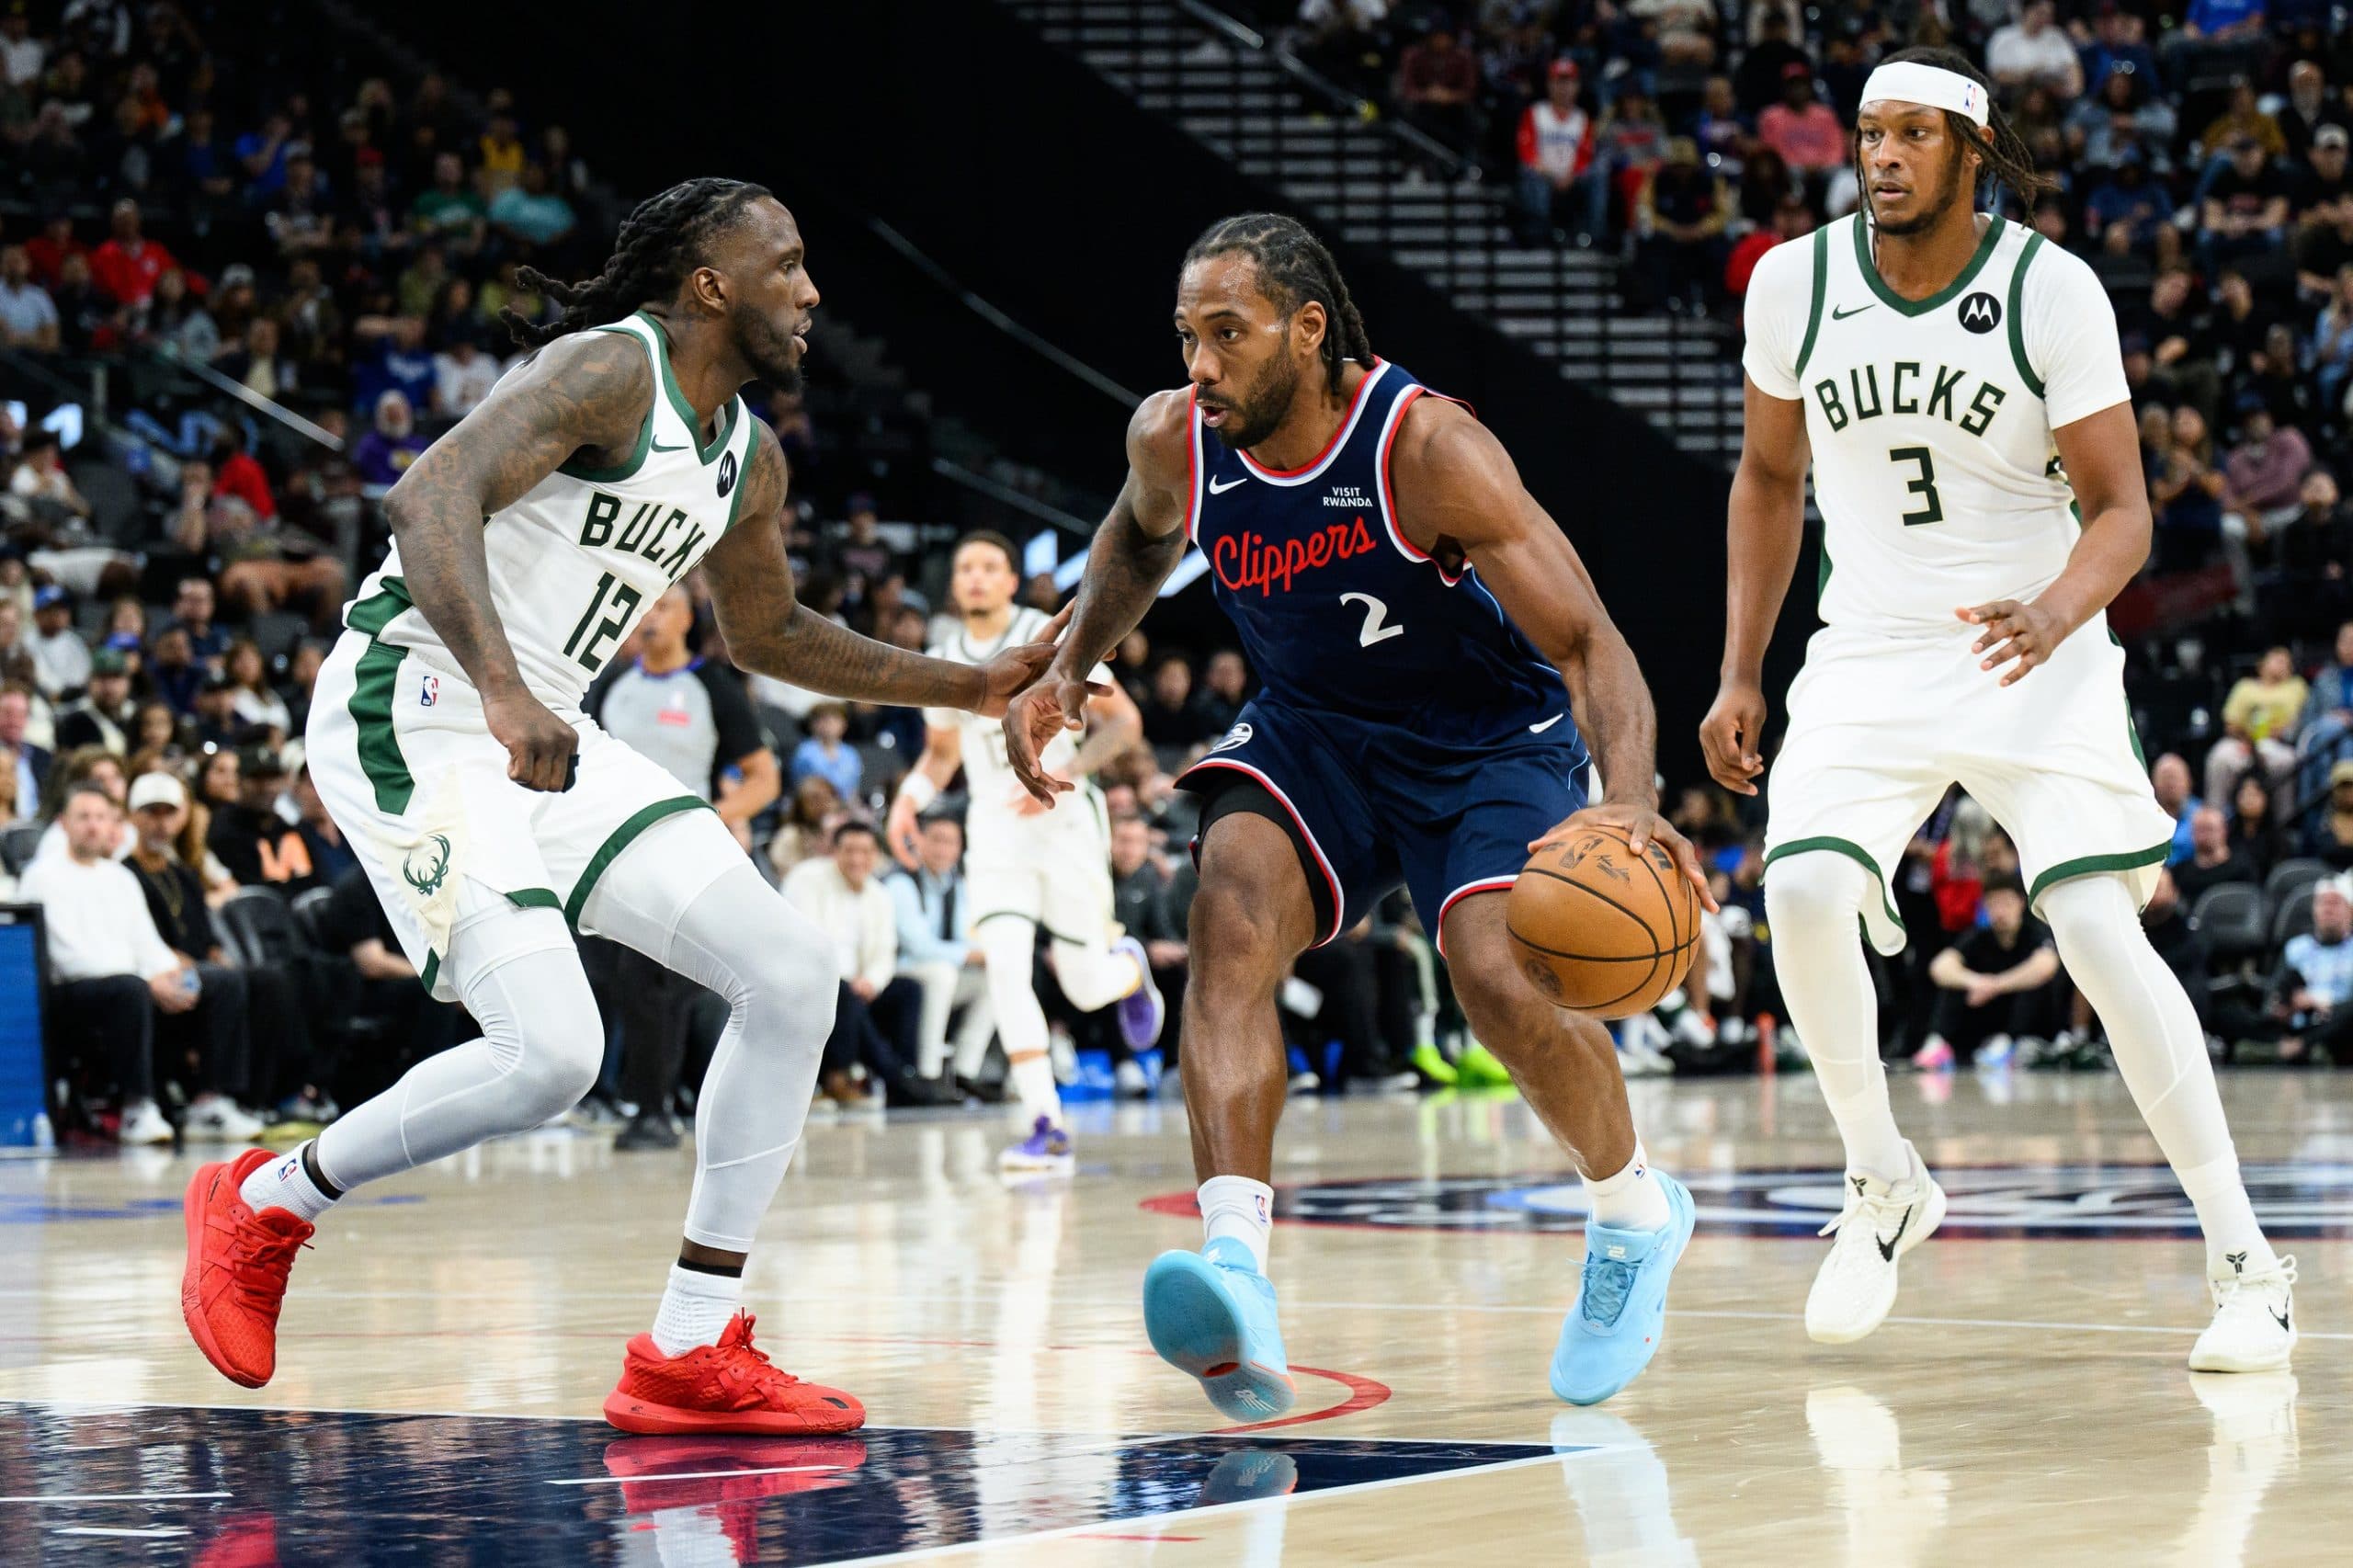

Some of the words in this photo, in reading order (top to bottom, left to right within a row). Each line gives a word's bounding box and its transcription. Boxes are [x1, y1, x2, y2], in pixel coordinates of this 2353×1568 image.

[1814, 362, 2006, 437] BUCKS
[1323, 497, 1373, 507] RWANDA
[1332, 486, 1360, 496] VISIT
[1890, 447, 1943, 526] 3
[579, 491, 710, 589] BUCK
[1214, 516, 1377, 597] Clippers
[563, 571, 642, 673] 12
[1339, 592, 1404, 647] 2
